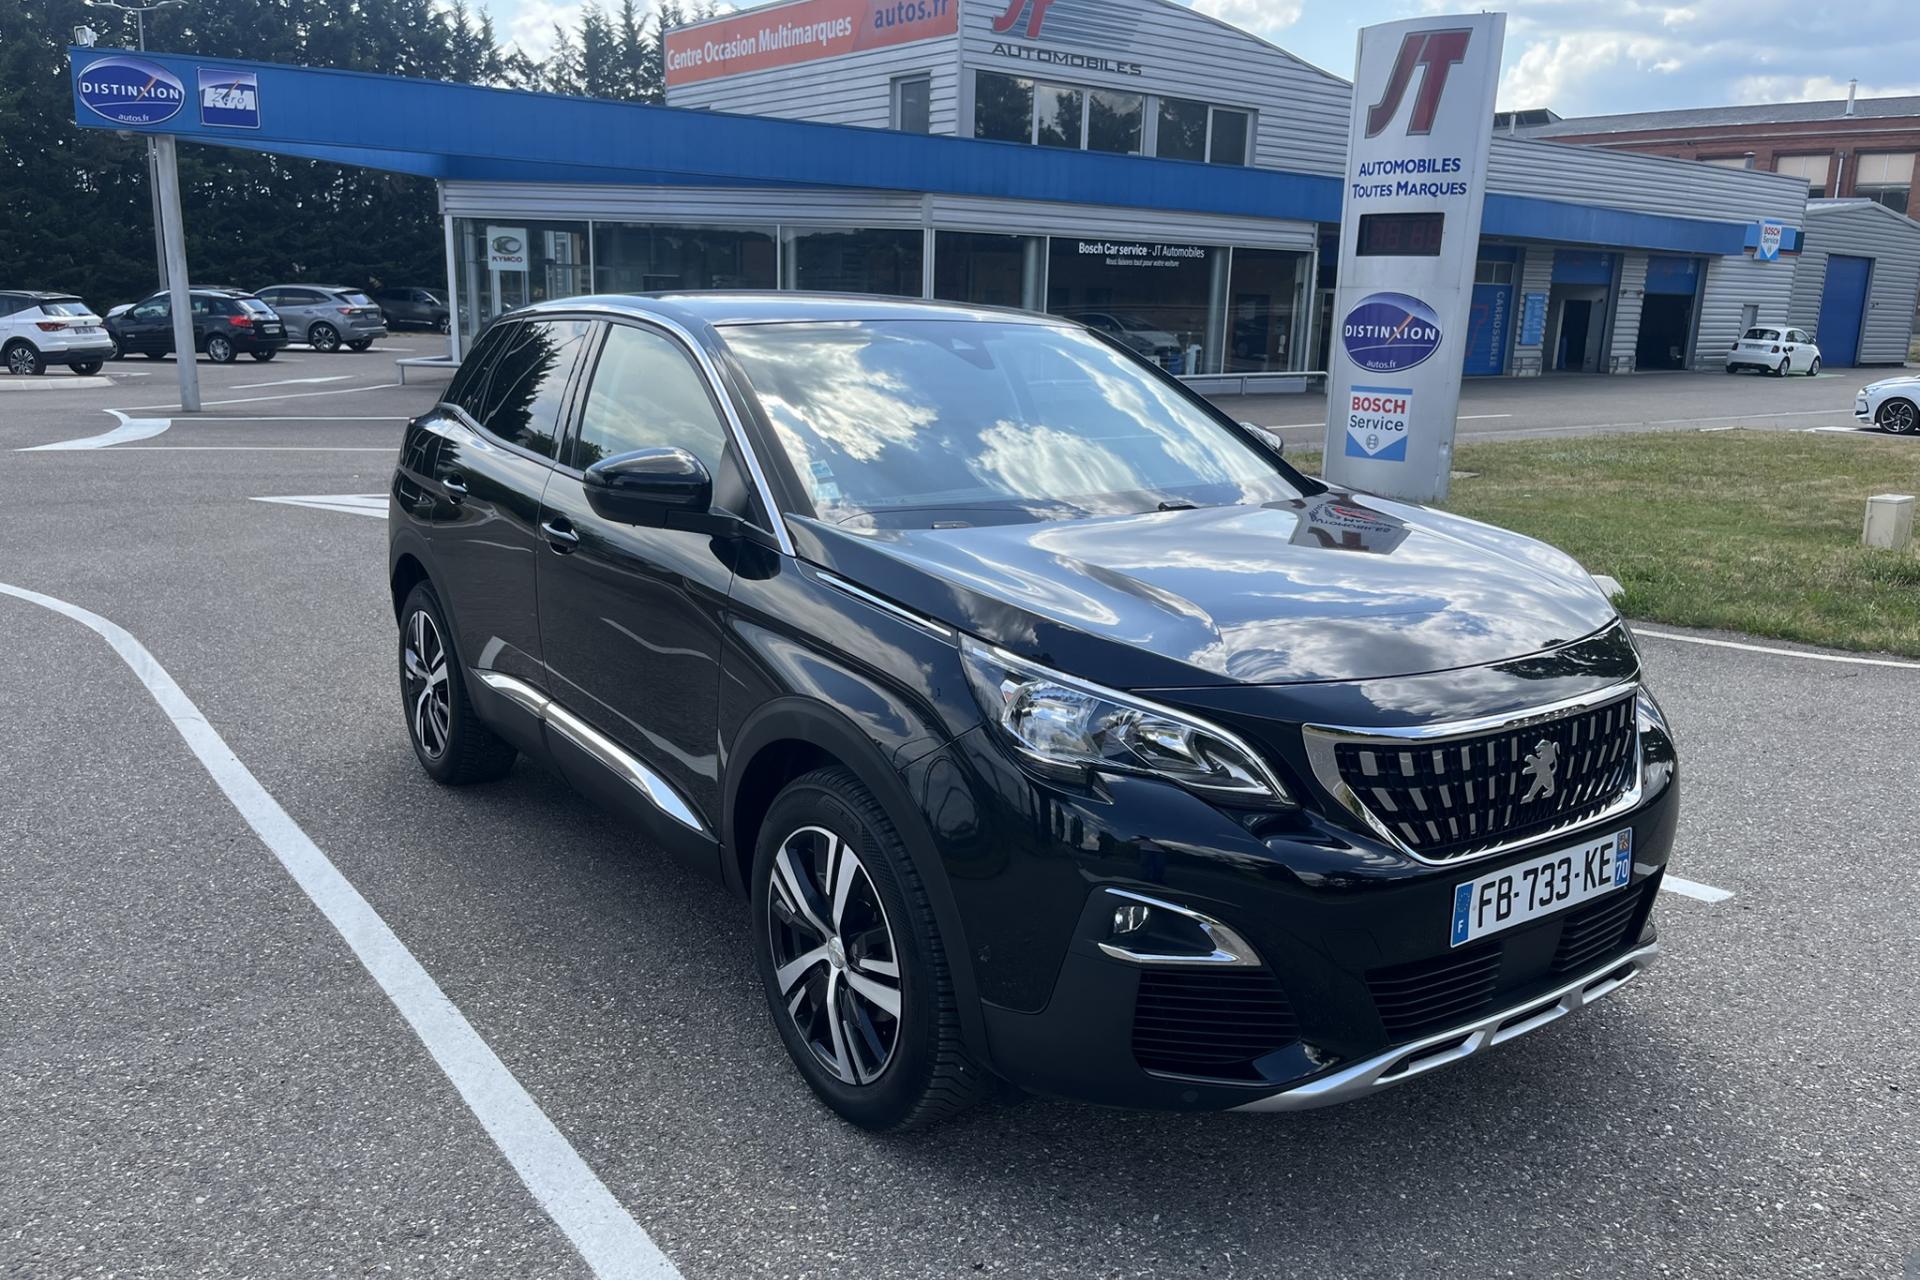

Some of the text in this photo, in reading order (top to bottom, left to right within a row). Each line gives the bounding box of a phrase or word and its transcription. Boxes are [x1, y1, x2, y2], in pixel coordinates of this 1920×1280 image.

[874, 0, 948, 28] autos.fr
[667, 16, 852, 71] Centre Occasion Multimarques
[992, 43, 1142, 75] AUTOMOBILES
[81, 81, 179, 100] DISTINXION
[1364, 27, 1473, 139] JT
[203, 87, 256, 111] KM
[118, 113, 150, 122] autos.fr
[1358, 158, 1461, 177] AUTOMOBILES
[1079, 242, 1102, 254] Bosch
[1104, 243, 1118, 254] Car
[1119, 244, 1147, 255] service
[1152, 245, 1161, 256] JT
[1162, 245, 1205, 258] Automobiles
[1345, 325, 1436, 341] DISTINXION
[1366, 360, 1396, 369] autos.fr
[1352, 396, 1406, 414] BOSCH
[1350, 415, 1404, 432] Service
[1616, 858, 1628, 879] 70
[1478, 842, 1614, 929] FB-733-KE
[1457, 919, 1464, 934] F
